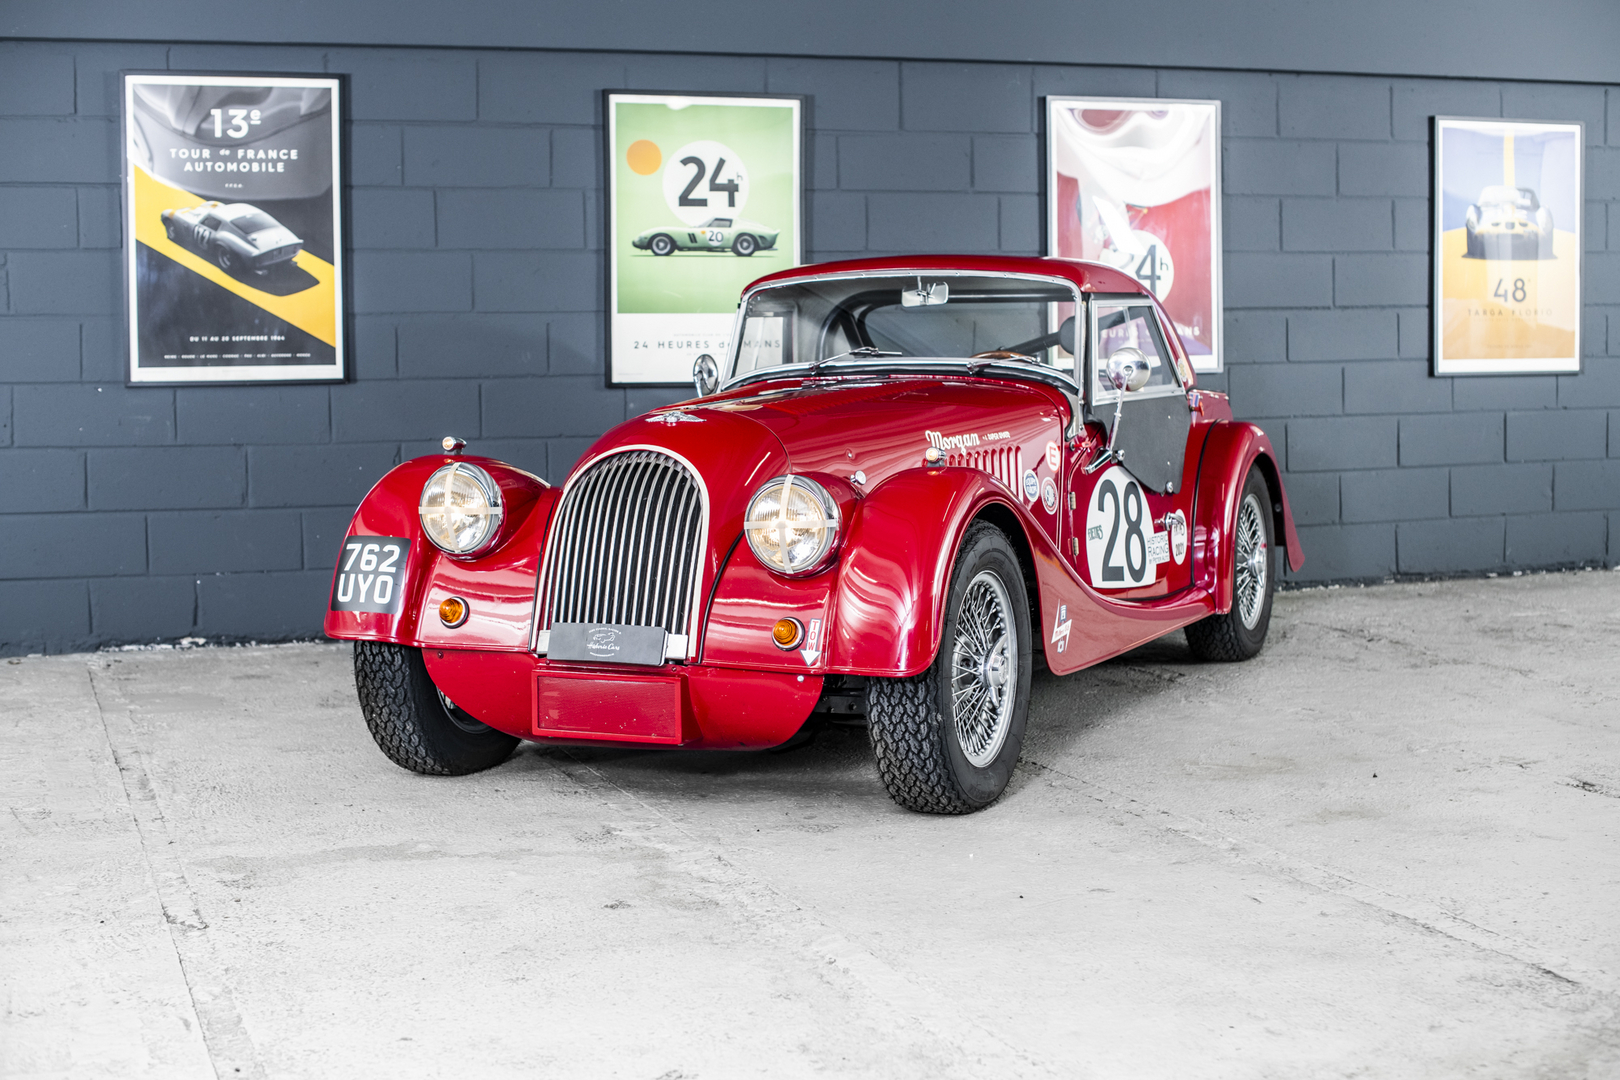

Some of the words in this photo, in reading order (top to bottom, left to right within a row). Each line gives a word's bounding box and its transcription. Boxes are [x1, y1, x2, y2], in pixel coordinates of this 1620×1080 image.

[170, 148, 211, 160] TOUR
[219, 148, 231, 156] de
[237, 149, 299, 160] FRANCE
[184, 161, 285, 173] AUTOMOBILE
[708, 231, 724, 243] 20
[1468, 308, 1504, 317] TARGA
[1511, 308, 1553, 317] FLORIO
[633, 340, 649, 349] 24
[657, 340, 710, 349] HEURES
[924, 429, 981, 456] Morgan
[1097, 478, 1147, 583] 28
[343, 543, 401, 573] 762
[1148, 543, 1168, 558] RACING
[337, 573, 394, 604] UYO
[808, 620, 819, 651] TOW
